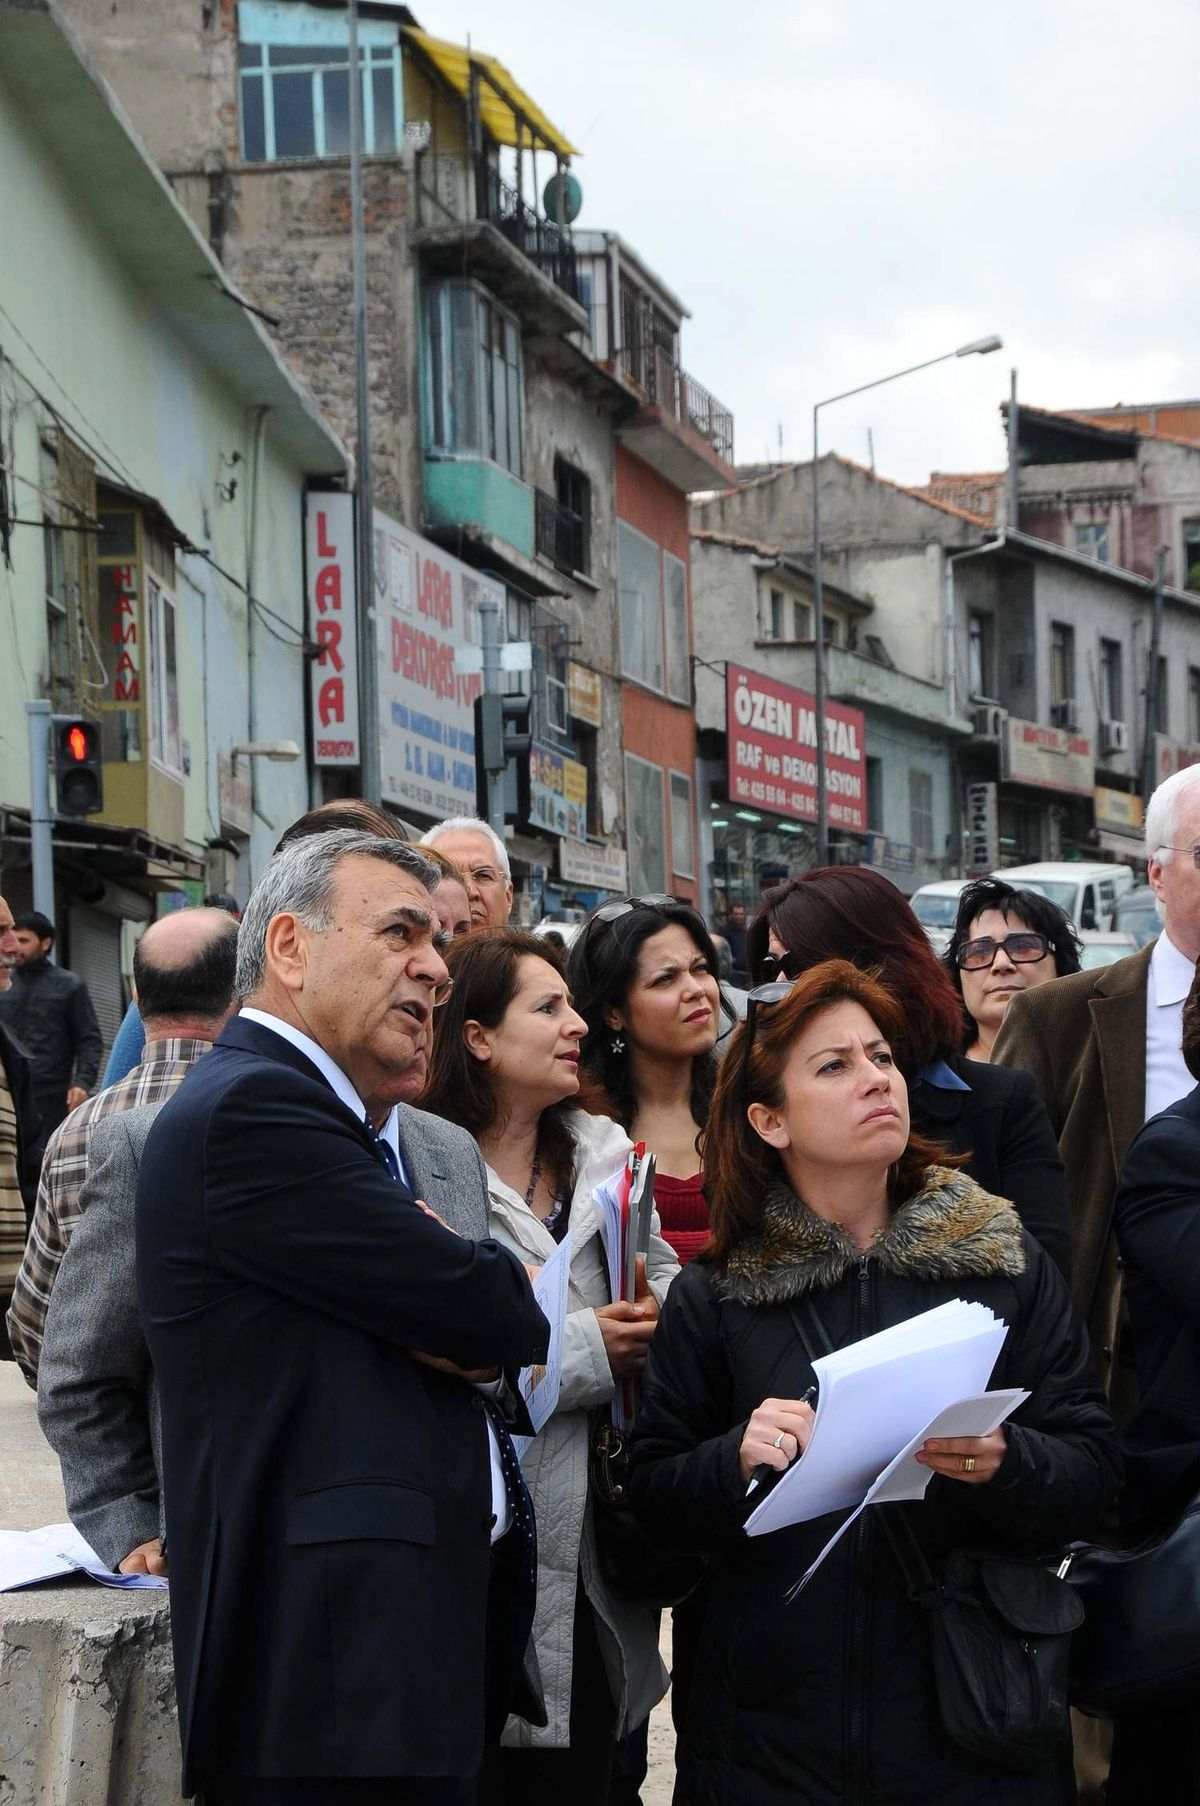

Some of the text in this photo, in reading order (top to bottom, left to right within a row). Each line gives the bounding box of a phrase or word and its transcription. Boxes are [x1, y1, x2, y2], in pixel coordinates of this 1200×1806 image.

[112, 565, 139, 702] HAMAM
[315, 511, 344, 727] LARA
[416, 551, 453, 631] LARA
[735, 674, 860, 761] ÖZEN MTAL
[736, 740, 861, 799] RAF ve DEKOASYON
